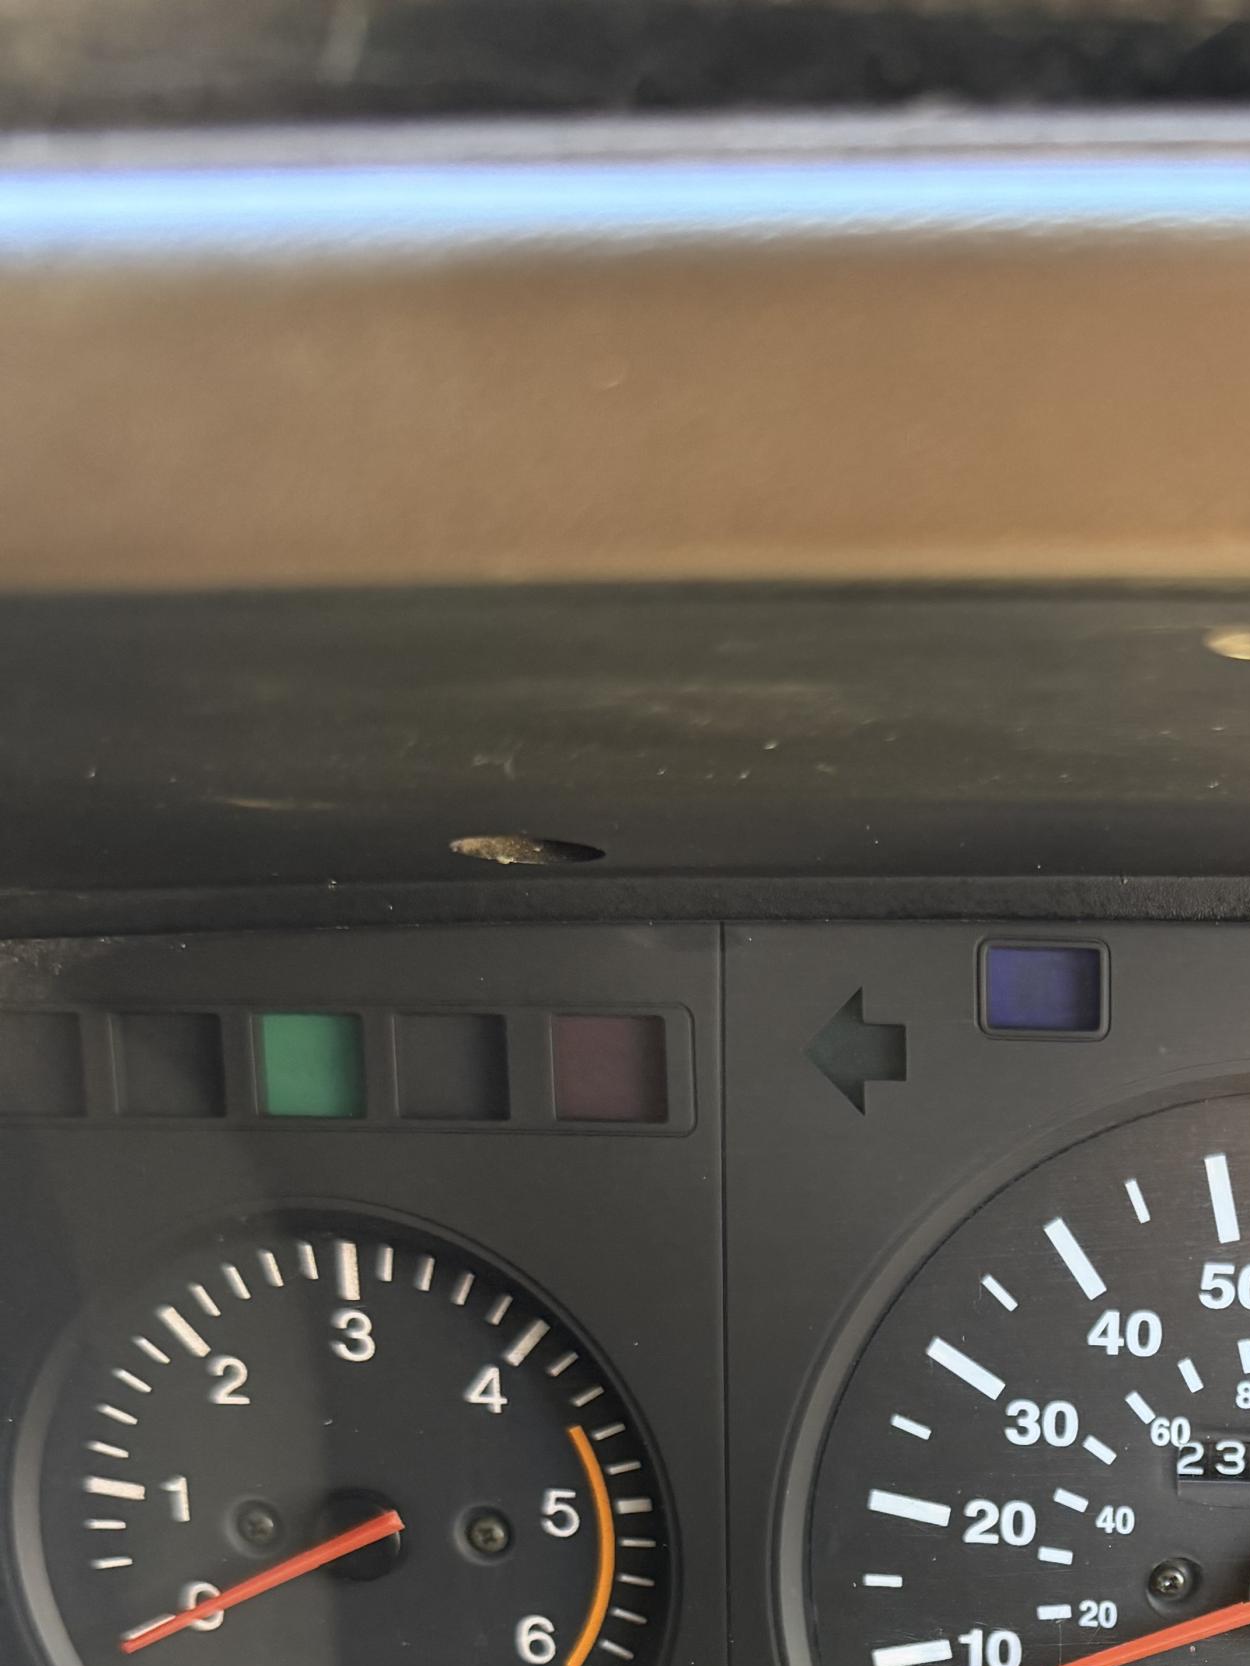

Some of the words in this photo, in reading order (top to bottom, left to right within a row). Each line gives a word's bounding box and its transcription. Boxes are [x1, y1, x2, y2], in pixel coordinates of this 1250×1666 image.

[331, 1311, 376, 1362] 3
[1087, 1308, 1163, 1358] 40
[210, 1357, 250, 1406] 2
[464, 1364, 507, 1413] 4
[1004, 1400, 1079, 1447] 30
[1150, 1416, 1191, 1447] 60
[160, 1475, 191, 1522] 1
[540, 1488, 580, 1538] 5
[962, 1499, 1037, 1546] 20
[1095, 1505, 1136, 1534] 40
[182, 1580, 226, 1632] 0
[1078, 1600, 1118, 1629] 20
[515, 1615, 556, 1665] 6
